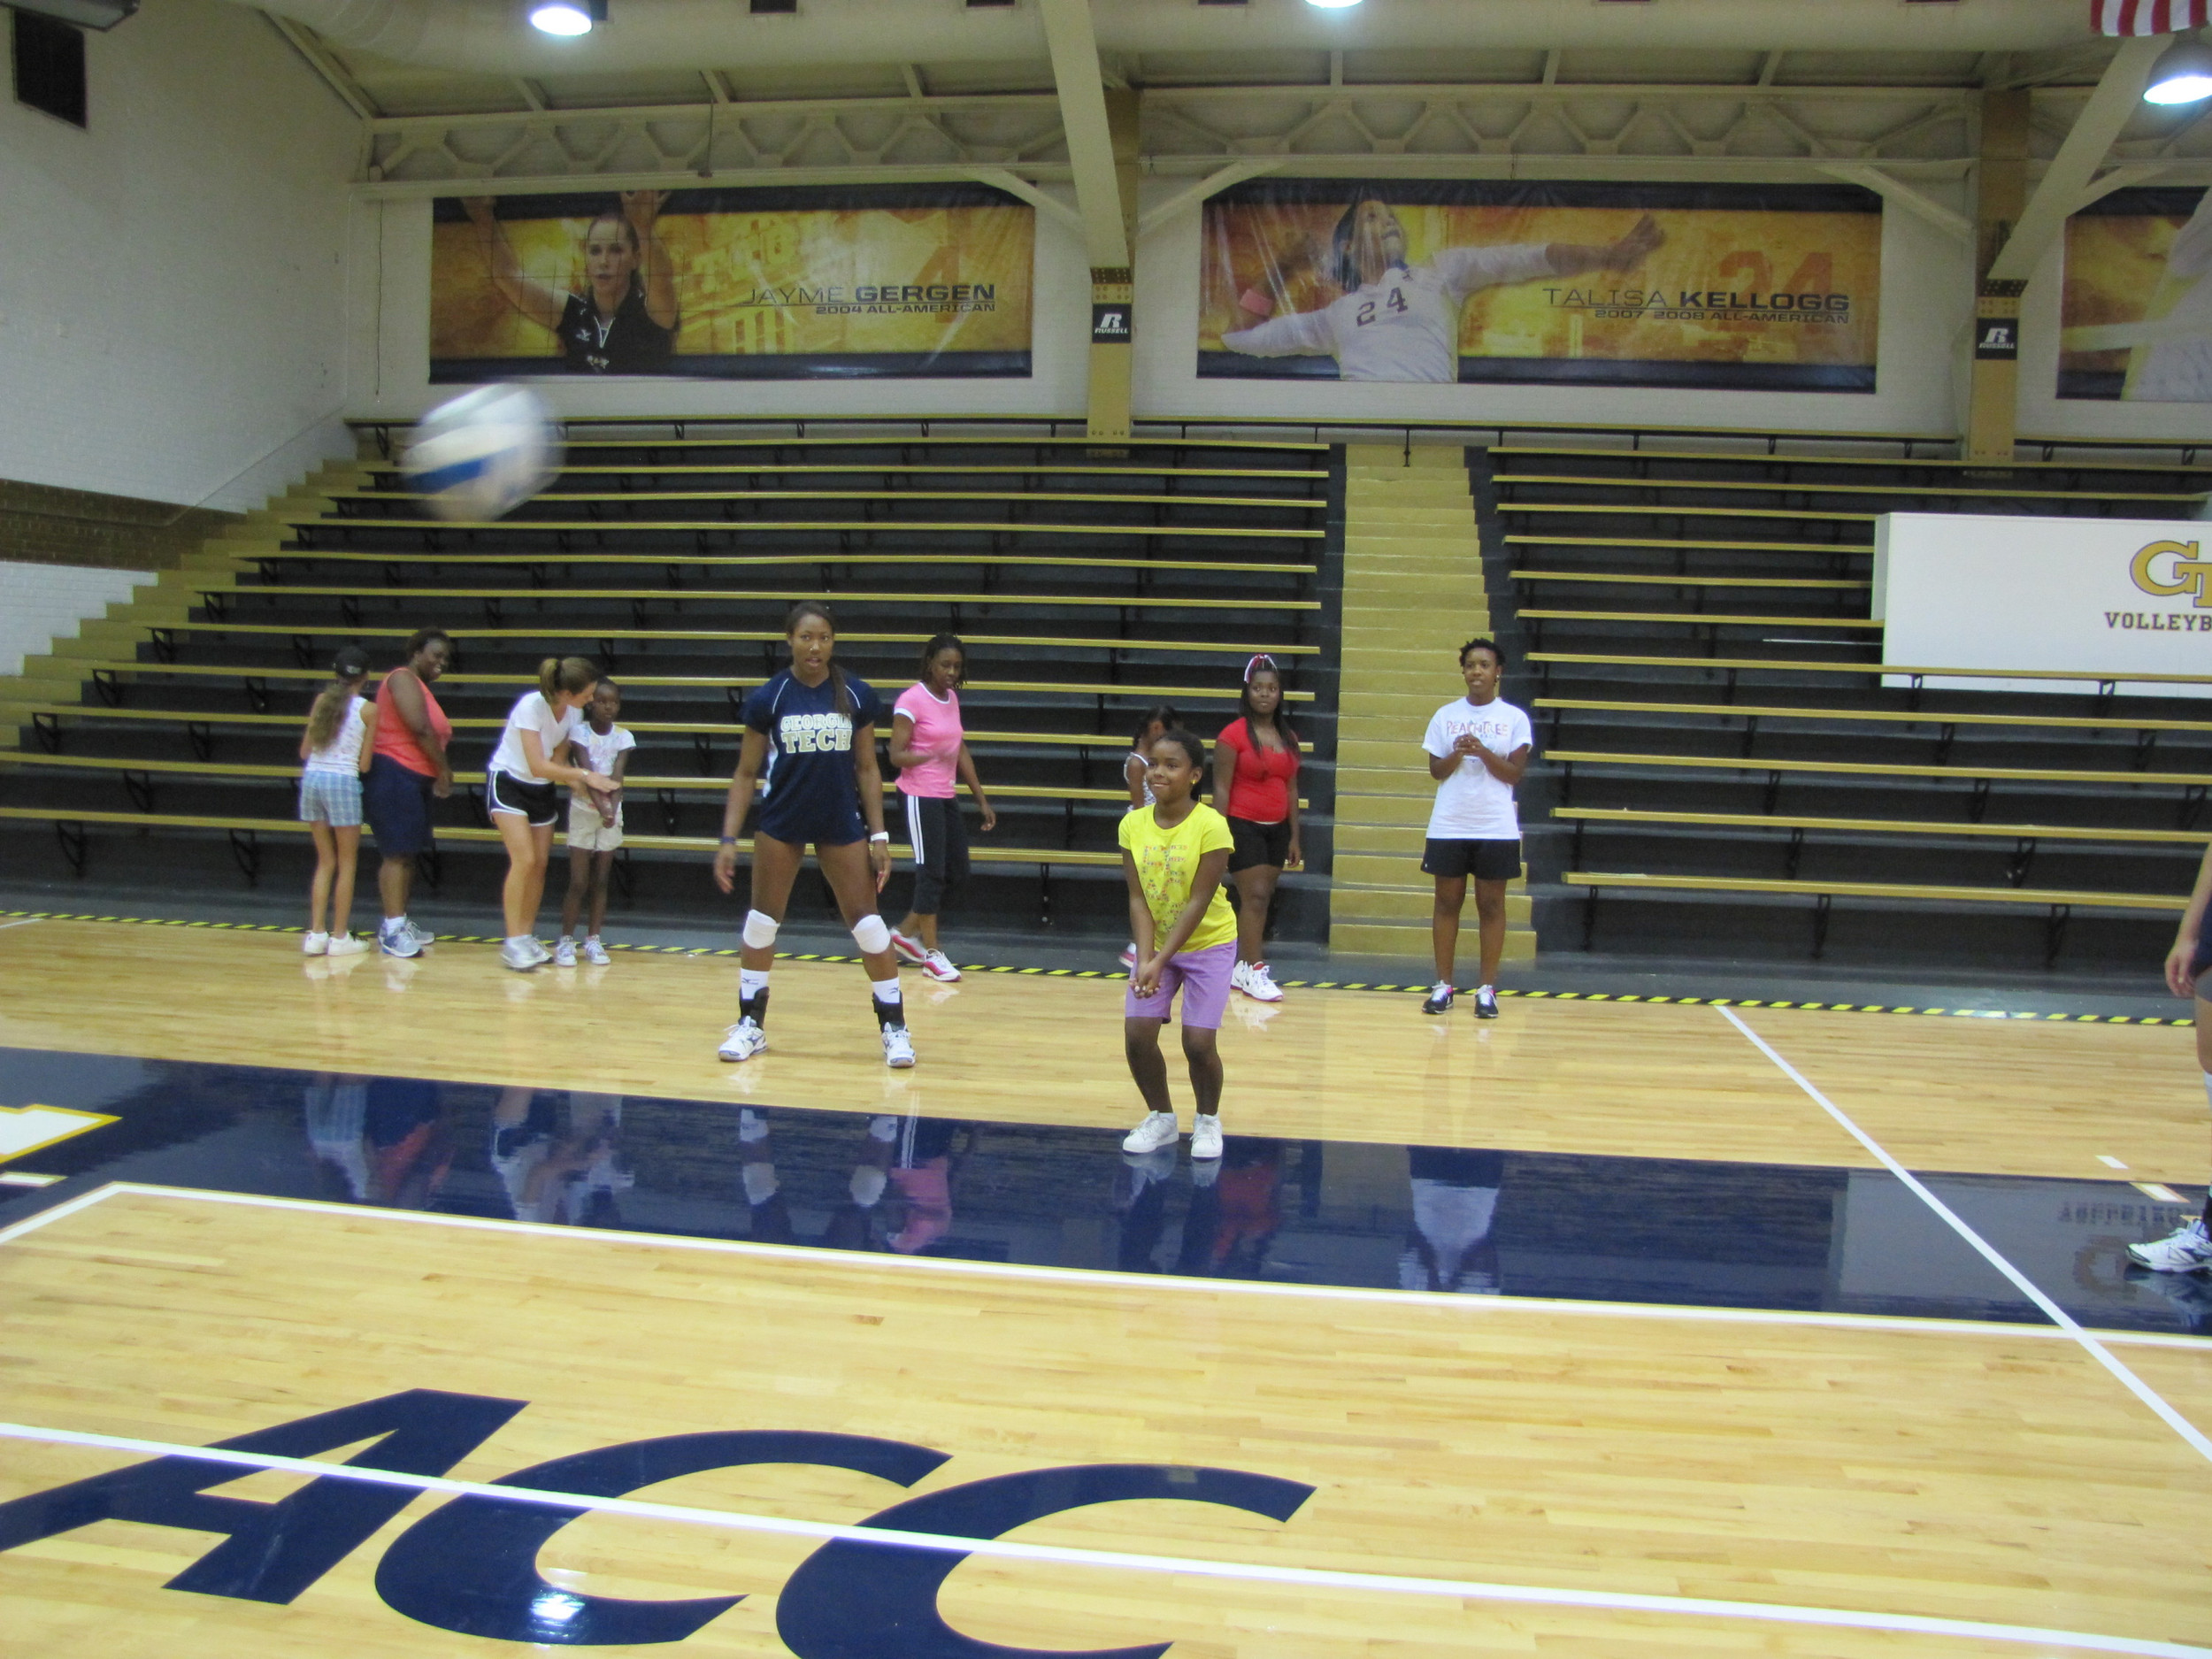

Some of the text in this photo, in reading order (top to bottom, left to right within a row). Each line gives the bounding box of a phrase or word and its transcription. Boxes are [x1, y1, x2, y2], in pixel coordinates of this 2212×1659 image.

[738, 284, 995, 304] JAYME GERGEN
[1542, 288, 1850, 311] TALISA KELLOGG
[816, 303, 996, 314] 2004 ALL-AMERICAN
[1356, 287, 1409, 326] 24
[1594, 310, 1849, 324] 2007 2008 ALL-AMERICAN
[2104, 611, 2212, 631] VOLLEYB
[781, 728, 853, 754] TECH
[0, 1387, 1317, 1659] ACC
